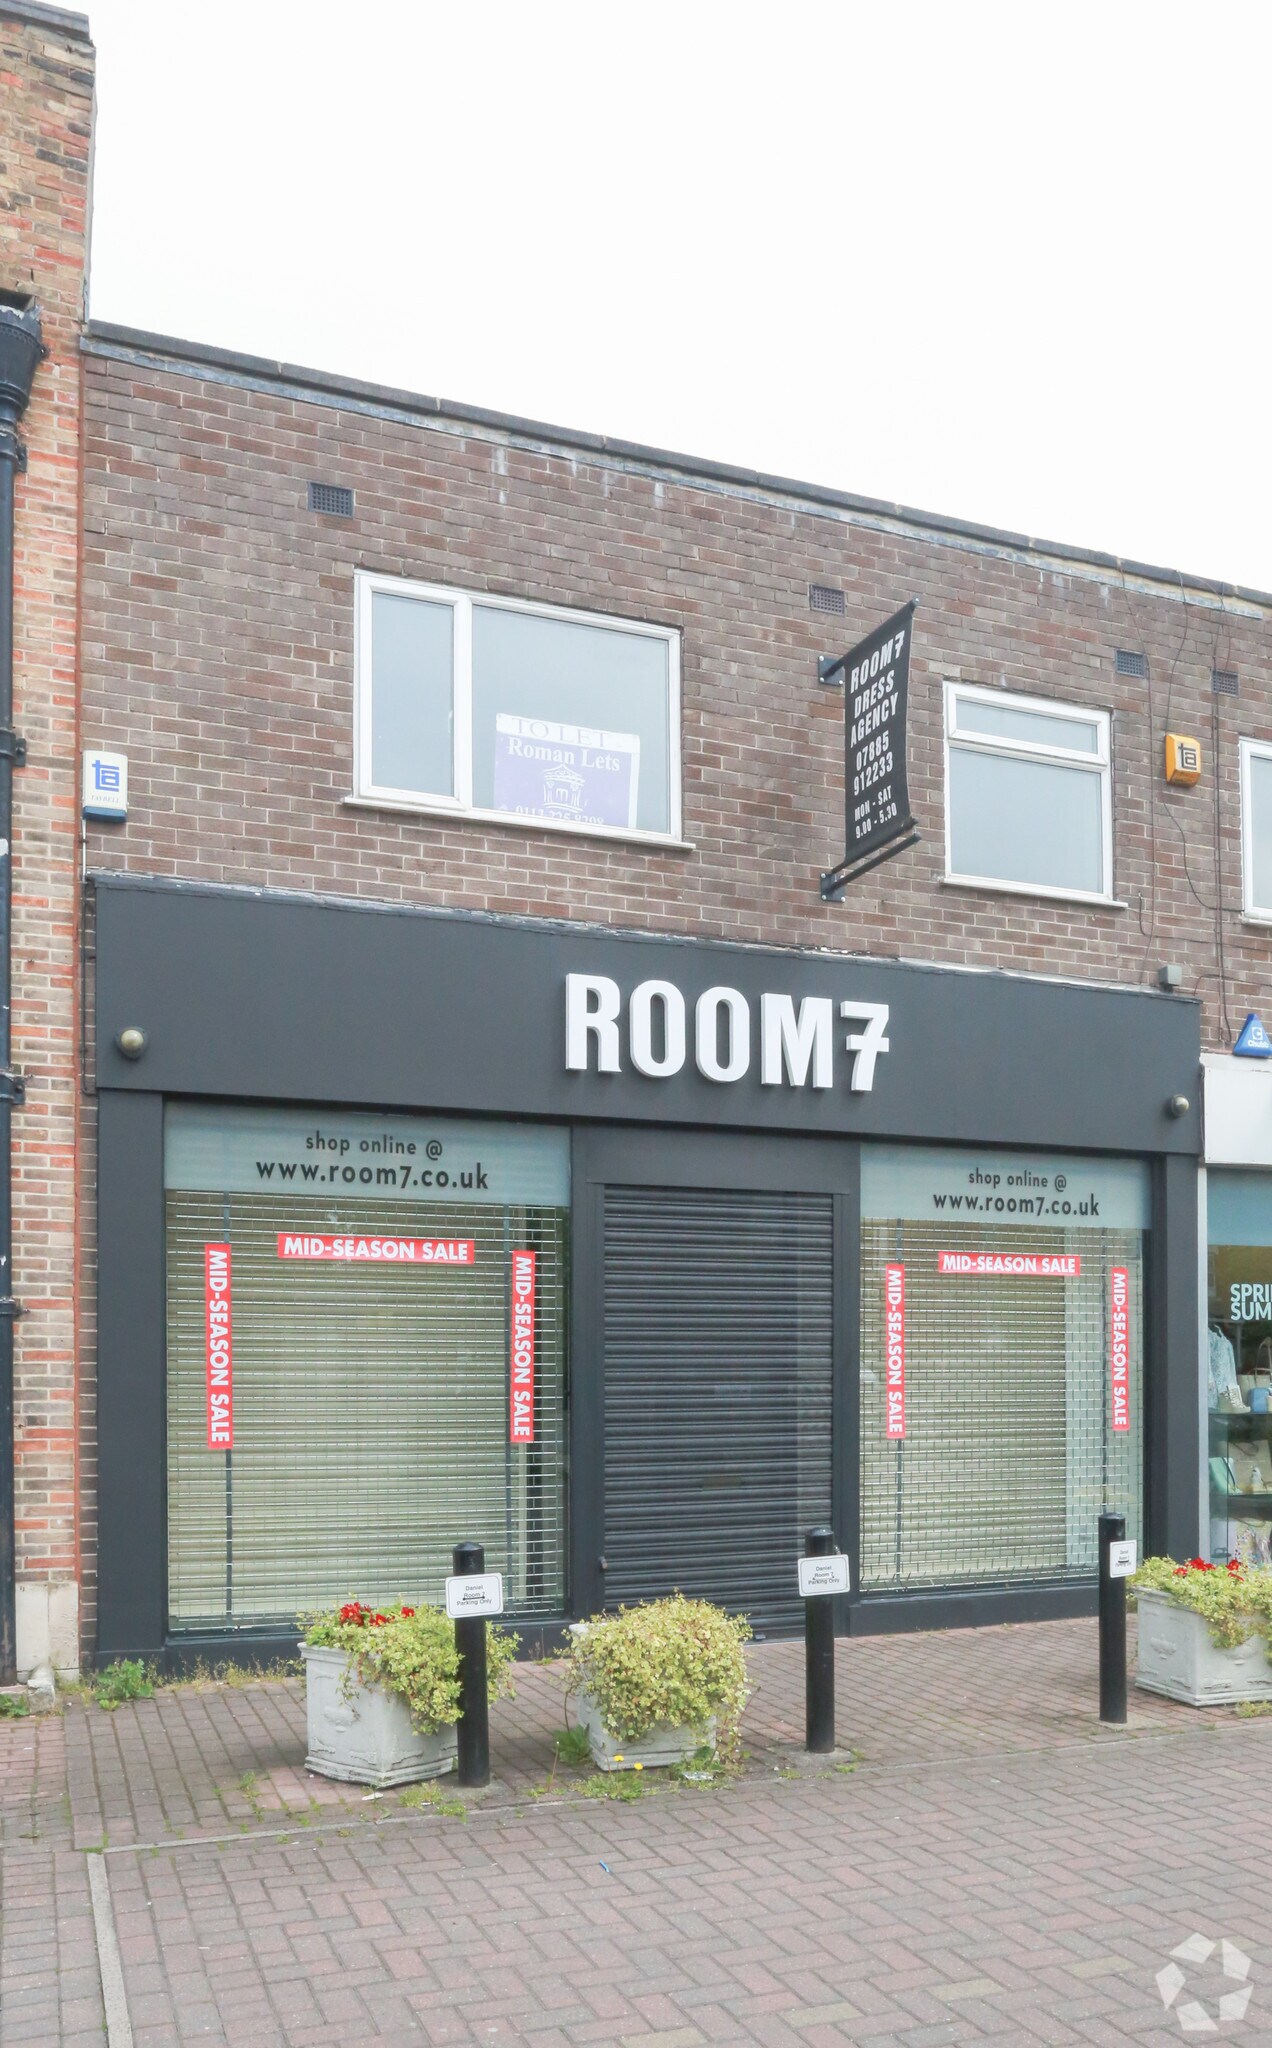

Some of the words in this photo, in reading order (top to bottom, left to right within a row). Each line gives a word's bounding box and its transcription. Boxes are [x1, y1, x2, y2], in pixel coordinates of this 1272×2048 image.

[850, 630, 905, 694] ROOM7
[854, 670, 895, 719] DRESS
[512, 717, 549, 739] TO
[560, 725, 609, 748] LET
[850, 691, 899, 748] AGENCY
[507, 736, 575, 765] Roman
[581, 748, 620, 772] Lets
[856, 730, 889, 771] 07885
[853, 751, 893, 796] 912233
[854, 800, 871, 822] MON
[877, 785, 892, 806] SAT
[855, 818, 872, 839] 9.00
[879, 802, 898, 824] 5.30
[565, 973, 890, 1091] ROOM7
[1247, 1039, 1270, 1048] Chubb
[306, 1130, 350, 1156] shop
[359, 1134, 416, 1155] online
[425, 1139, 443, 1161] @
[256, 1162, 489, 1190] www.room7.co.uk
[969, 1167, 1001, 1189] shop
[1007, 1170, 1048, 1188] online
[1054, 1174, 1067, 1192] @
[933, 1193, 1100, 1217] www.room7.co.uk
[284, 1237, 415, 1259] MID-SEASON
[422, 1242, 468, 1261] SALE
[942, 1254, 1037, 1272] MID-SEASON
[1041, 1258, 1076, 1273] SALE
[1230, 1283, 1272, 1302] SPRI
[208, 1250, 229, 1386] MID-SEASON
[513, 1256, 532, 1384] MID-SEASON
[888, 1269, 903, 1385] MID-SEASON
[1113, 1272, 1127, 1381] MID-SEASON
[210, 1393, 230, 1443] SALE
[513, 1390, 531, 1437] SALE
[888, 1391, 903, 1433] SALE
[1114, 1386, 1127, 1425] SALE
